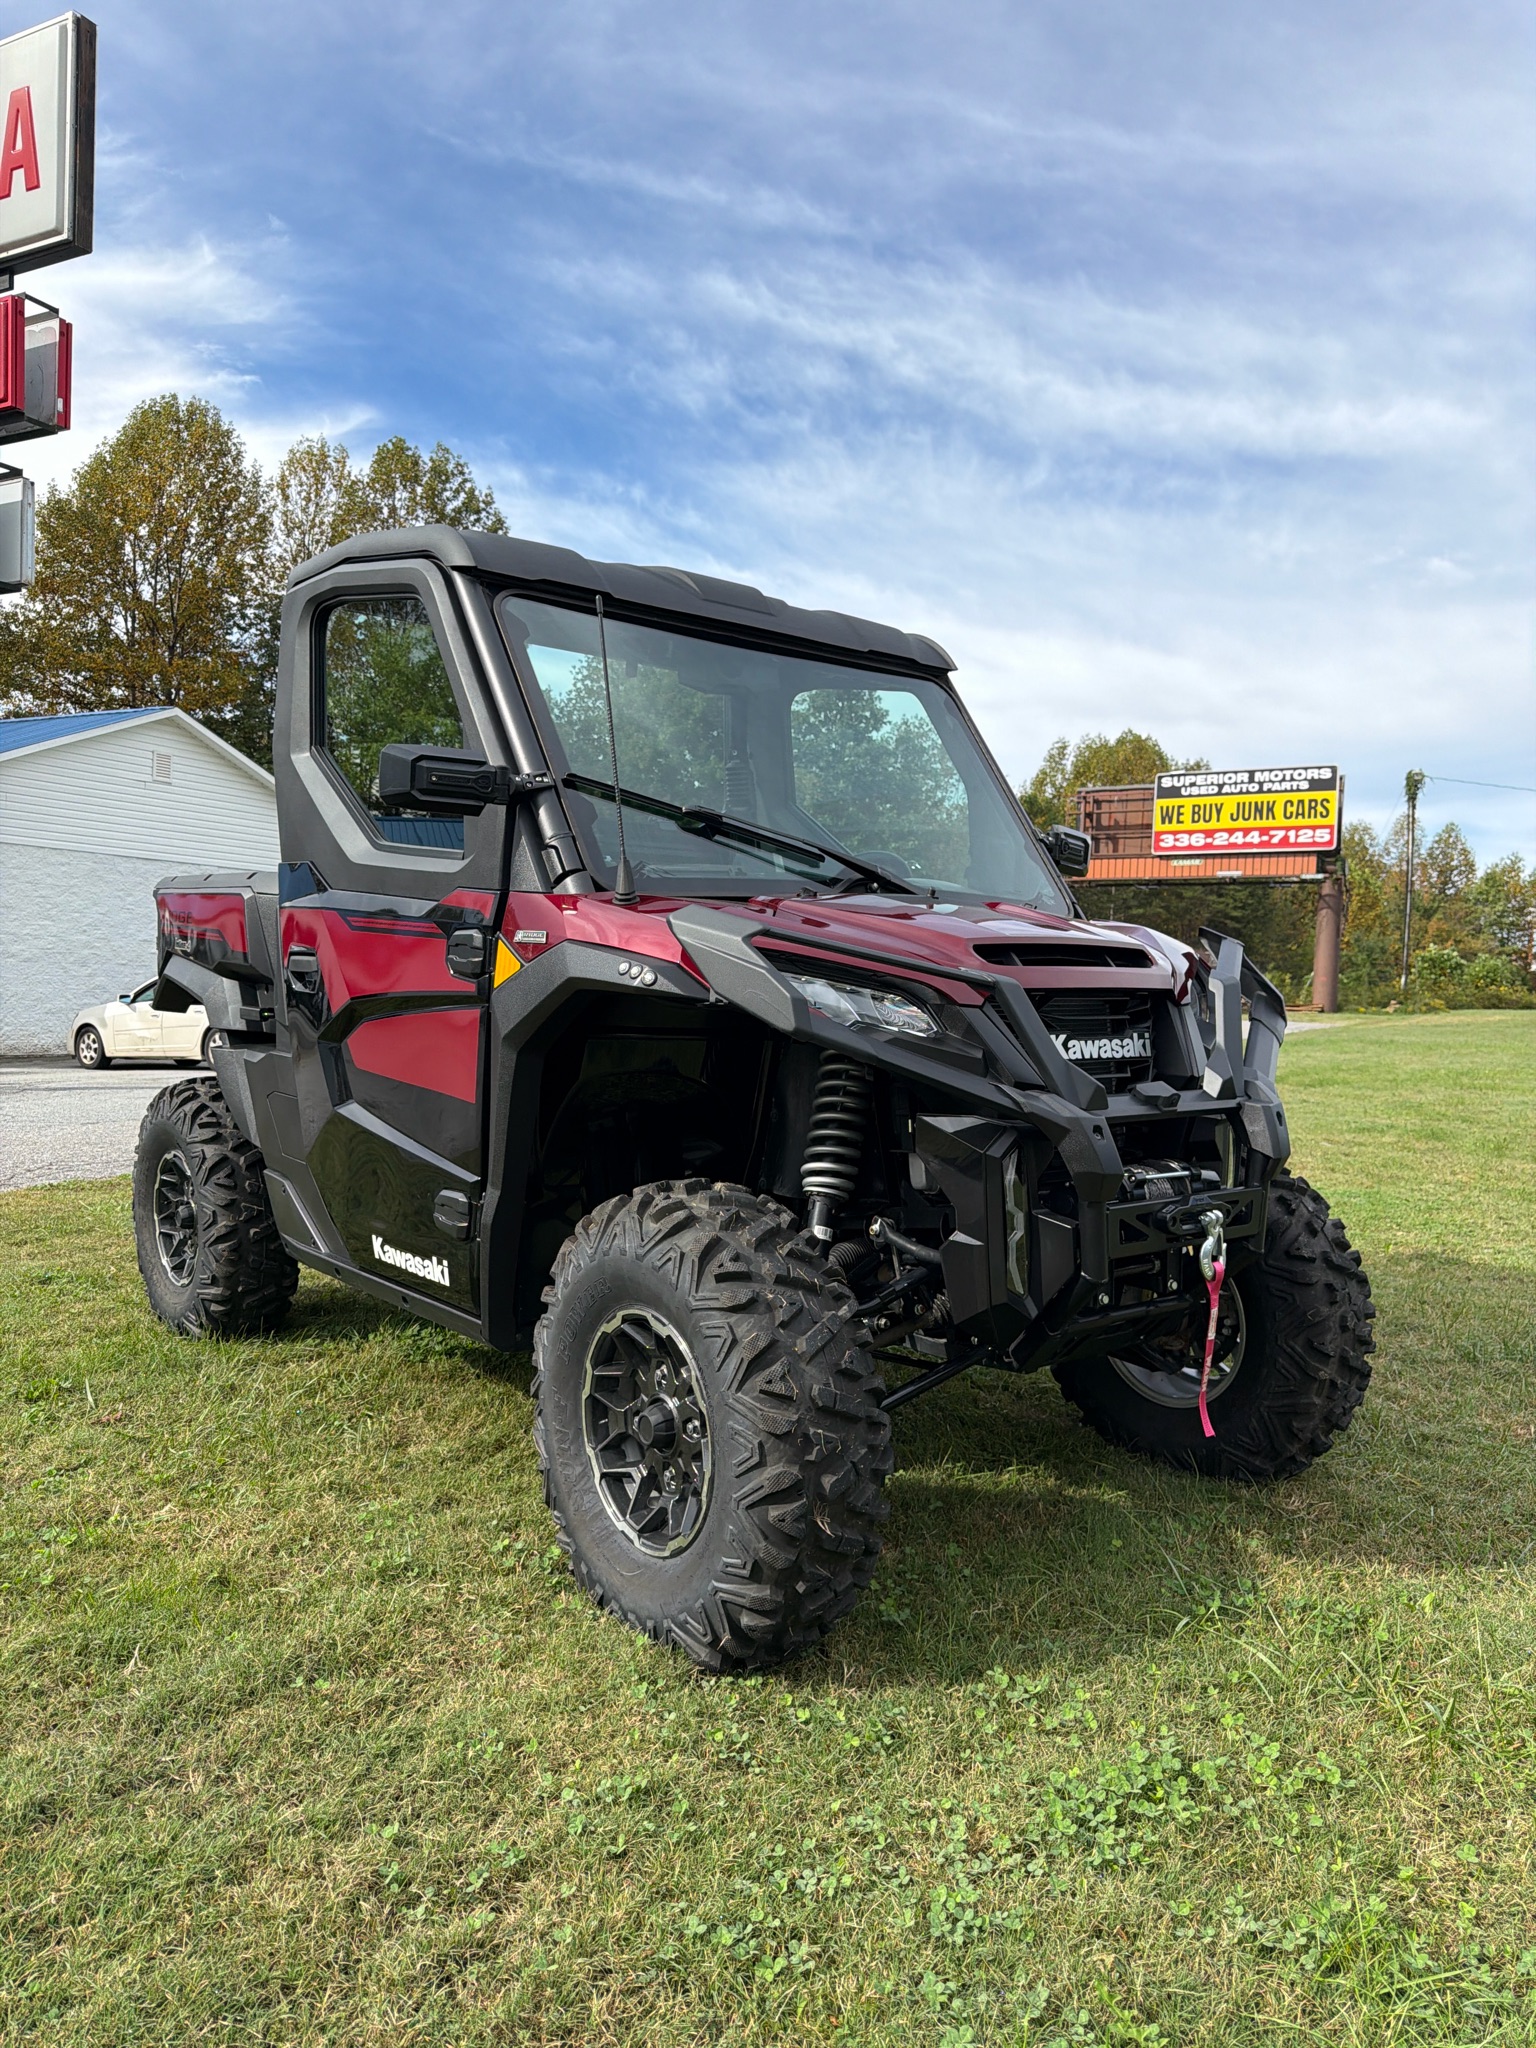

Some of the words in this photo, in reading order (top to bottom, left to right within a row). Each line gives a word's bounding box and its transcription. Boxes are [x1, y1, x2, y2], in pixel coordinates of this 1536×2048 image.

[1161, 772, 1249, 787] SUPERIOR
[1254, 768, 1332, 781] MOTORS
[1181, 785, 1218, 796] USED
[1222, 783, 1259, 793] AUTO
[1263, 781, 1309, 791] PARTS
[1160, 804, 1185, 825] WE
[1191, 802, 1224, 824] BUY
[1230, 800, 1277, 822] JUNK
[1283, 798, 1331, 820] CARS
[1159, 828, 1331, 848] 336-244-7125
[1050, 1033, 1152, 1060] Kawasaki
[371, 1234, 450, 1287] Kawasaki
[556, 1276, 614, 1365] POWER
